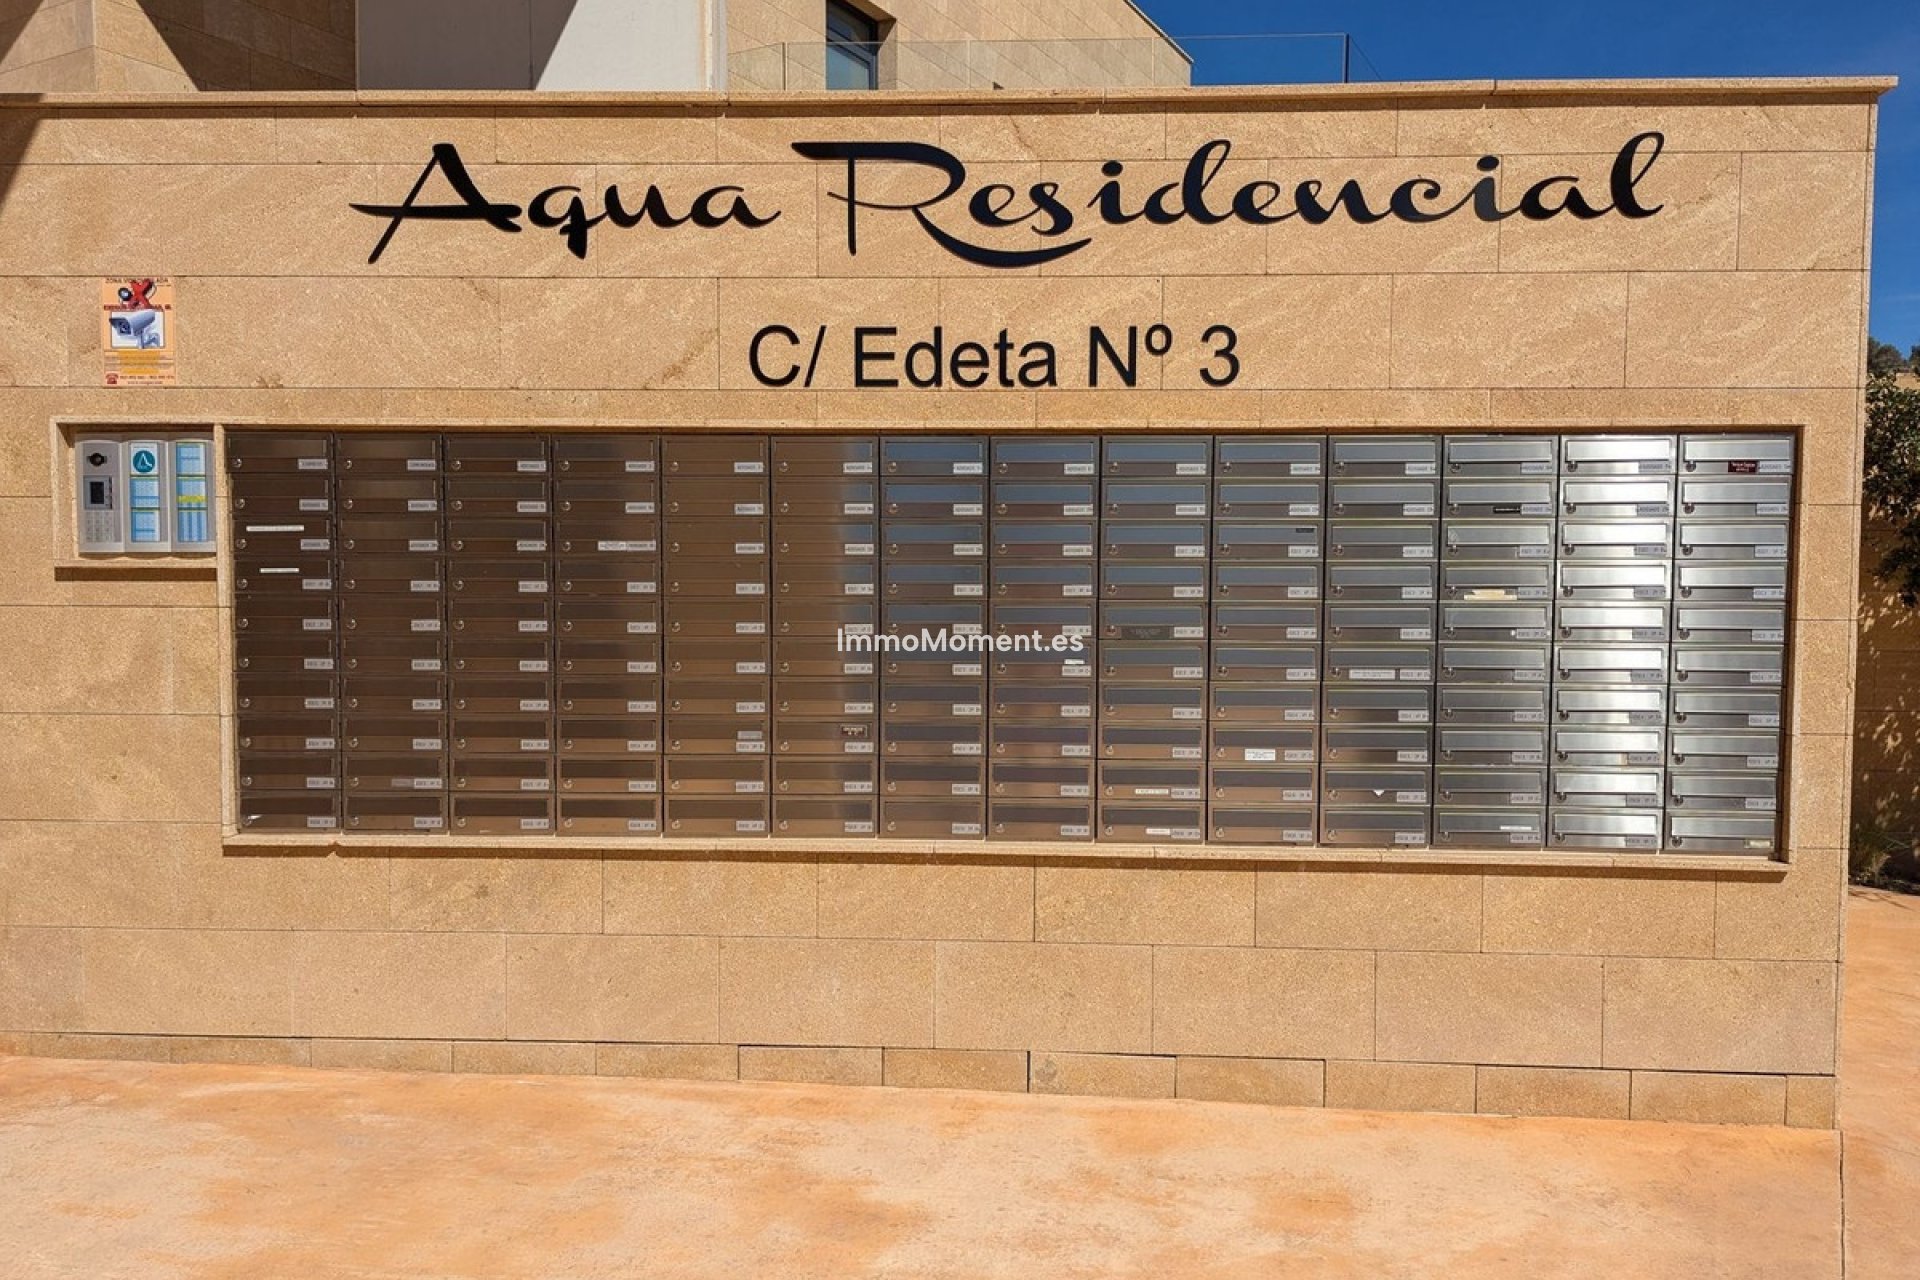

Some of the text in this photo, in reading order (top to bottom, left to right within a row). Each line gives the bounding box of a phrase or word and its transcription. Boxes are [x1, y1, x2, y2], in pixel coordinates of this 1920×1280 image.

[350, 130, 1665, 269] Aqua Residencial
[750, 325, 1240, 389] C/ Edeta Nº 3
